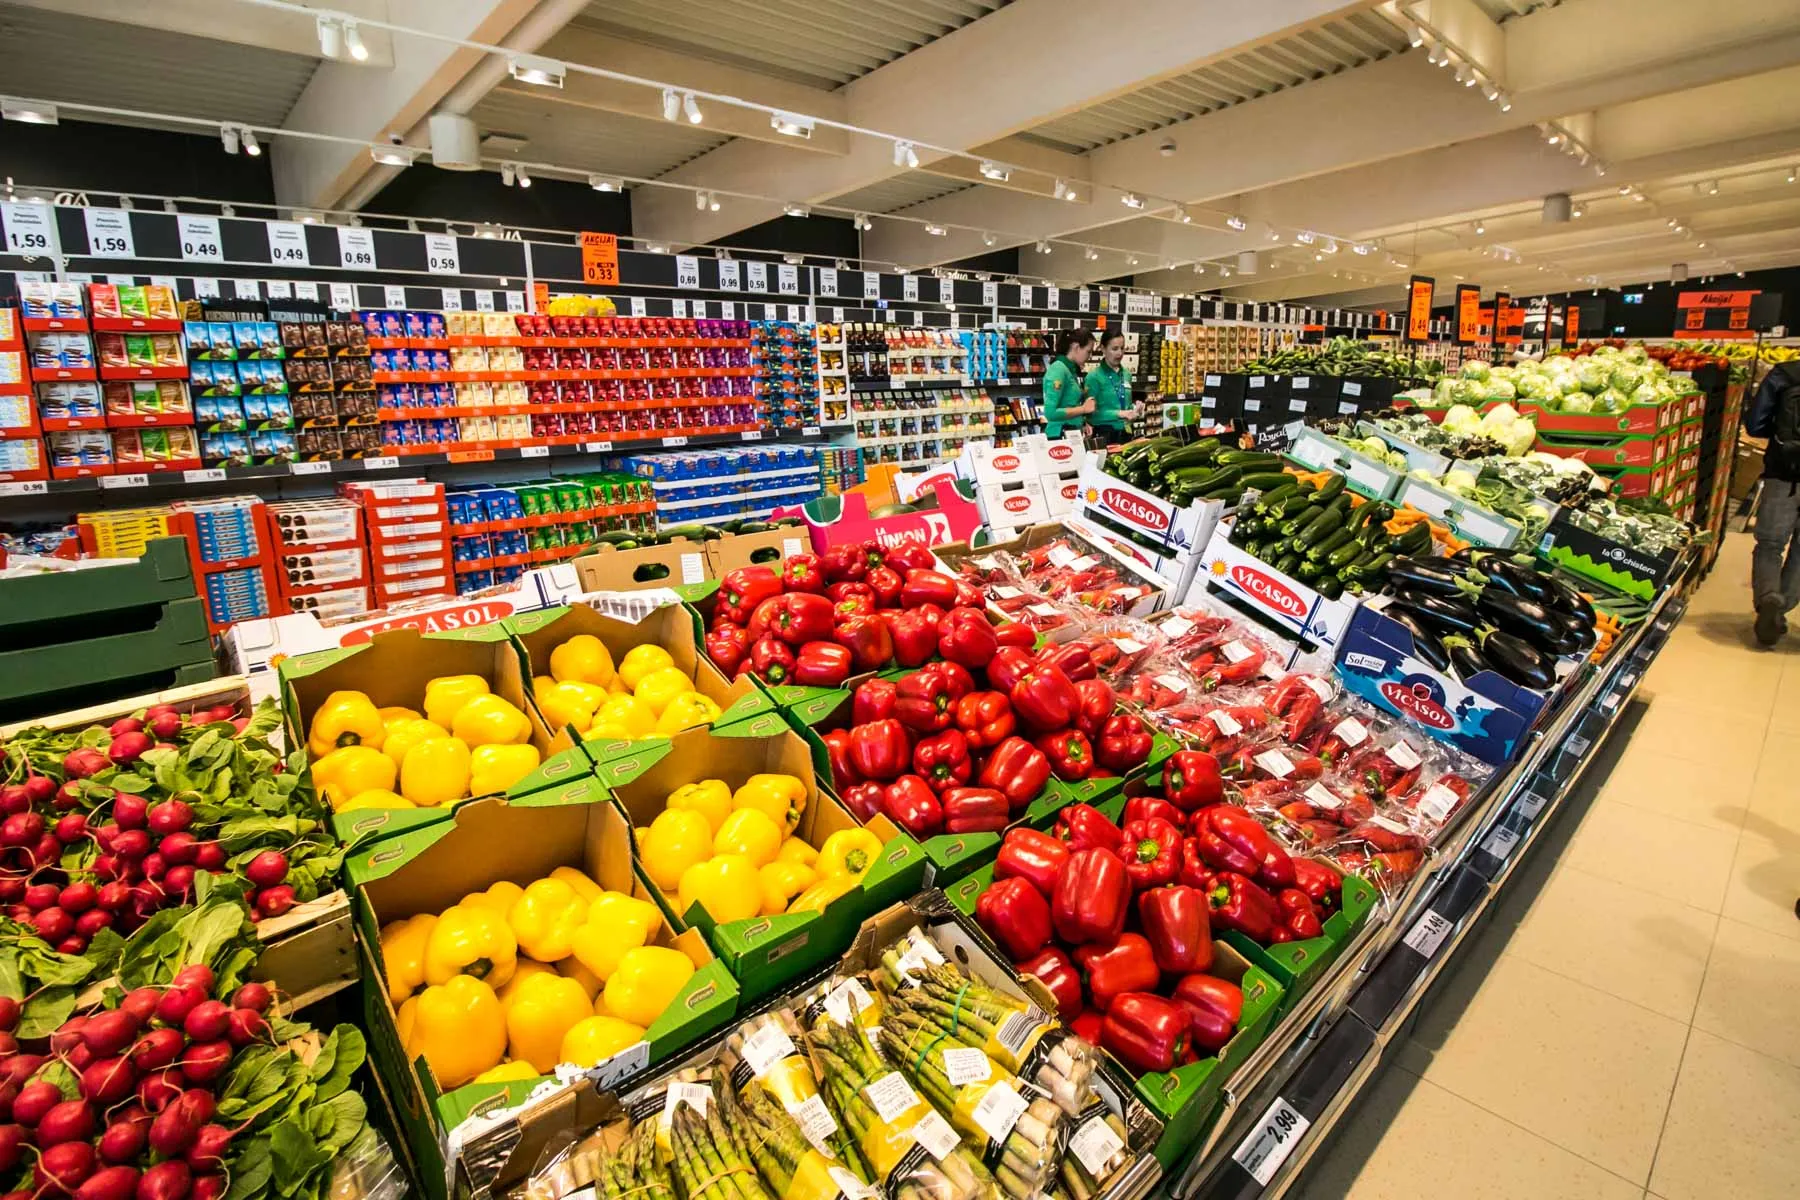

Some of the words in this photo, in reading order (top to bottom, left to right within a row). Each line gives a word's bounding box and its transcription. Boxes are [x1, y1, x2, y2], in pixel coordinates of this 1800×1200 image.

[11, 233, 46, 248] 1,59
[94, 238, 126, 251] 1,59
[584, 235, 614, 246] AKCIJA!
[184, 243, 217, 256] 0,49
[273, 248, 303, 260] 0,49
[345, 252, 371, 265] 0,69
[430, 257, 455, 269] 0,59
[588, 268, 613, 280] 0,33
[680, 275, 697, 285] 0,69
[721, 278, 737, 287] 0,99
[750, 280, 765, 289] 0,59
[1411, 318, 1427, 332] 0,49
[1460, 322, 1476, 335] 0,49
[1107, 490, 1164, 528] VICASOL
[875, 527, 887, 536] LA
[1601, 548, 1611, 557] la
[1623, 558, 1656, 575] chistera
[1237, 568, 1303, 615] VICASOL
[363, 606, 499, 637] ASOL
[1349, 654, 1365, 665] Sol
[1386, 685, 1449, 728] VICASOL
[1423, 915, 1444, 935] 3,49
[1266, 1109, 1297, 1144] 2,99
